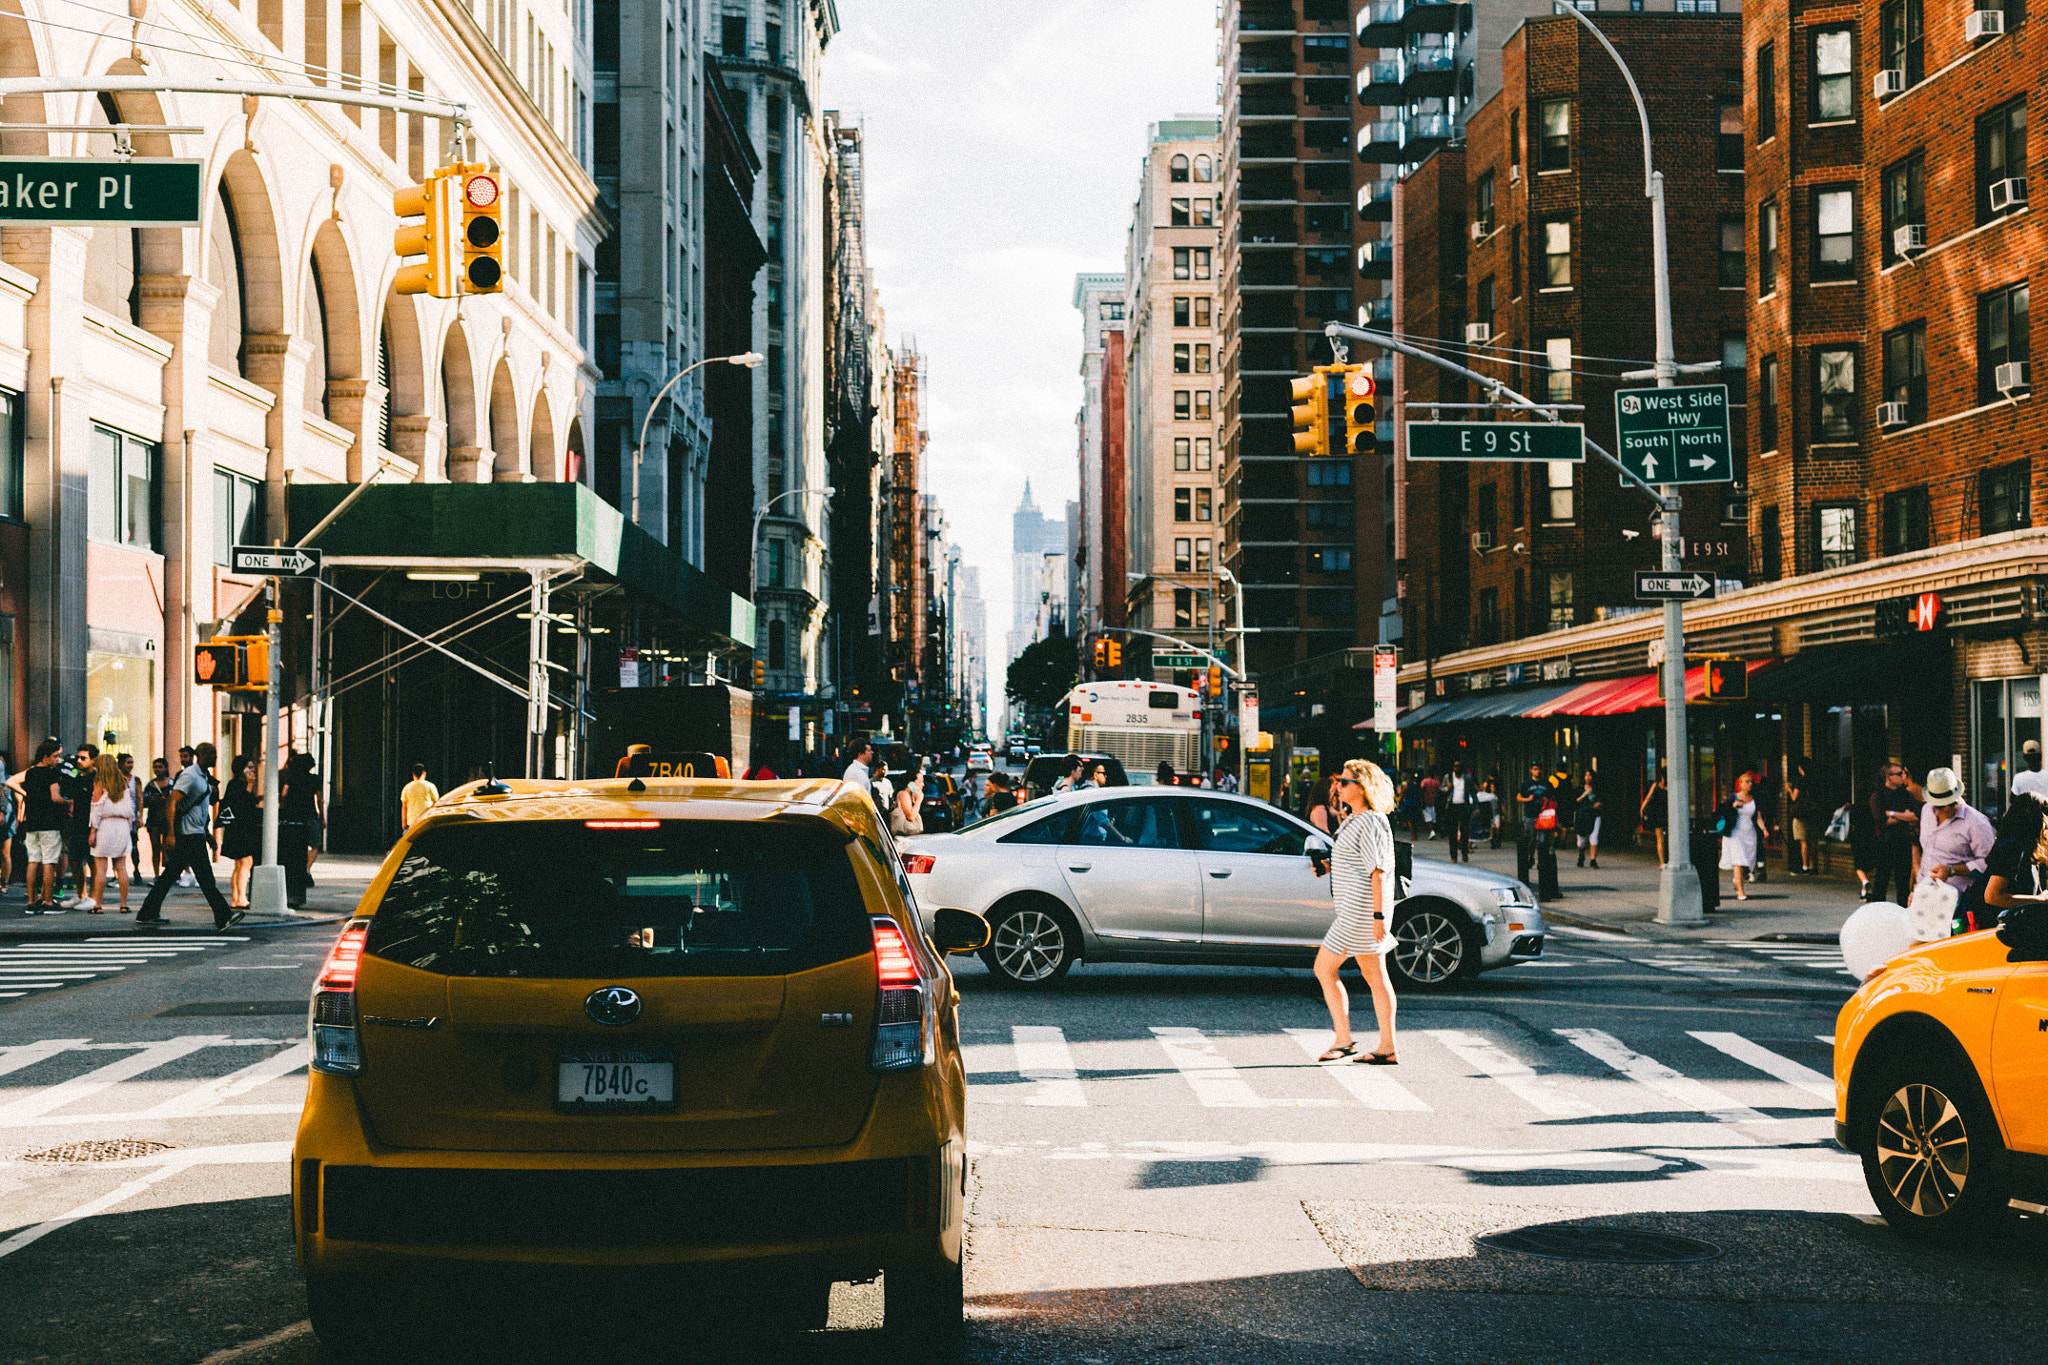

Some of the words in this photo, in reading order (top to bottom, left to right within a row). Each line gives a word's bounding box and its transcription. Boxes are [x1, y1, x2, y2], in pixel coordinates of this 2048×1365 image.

[99, 175, 133, 209] Pl
[1623, 398, 1640, 412] 9A
[1644, 394, 1683, 410] West
[1689, 391, 1722, 407] Side
[1668, 411, 1701, 427] Hwy
[1461, 430, 1472, 452] E
[1484, 430, 1497, 452] 9
[1509, 430, 1532, 453] St
[1625, 434, 1669, 448] South
[1680, 432, 1721, 445] North
[1693, 542, 1699, 556] E
[1704, 542, 1712, 556] 9
[1716, 541, 1728, 556] St
[244, 555, 269, 567] ONE
[281, 556, 307, 568] WAY
[432, 581, 495, 599] LOFT
[1647, 580, 1671, 591] ONE
[1681, 580, 1704, 591] WAY
[1126, 713, 1148, 723] 2835
[648, 762, 694, 777] 7B40
